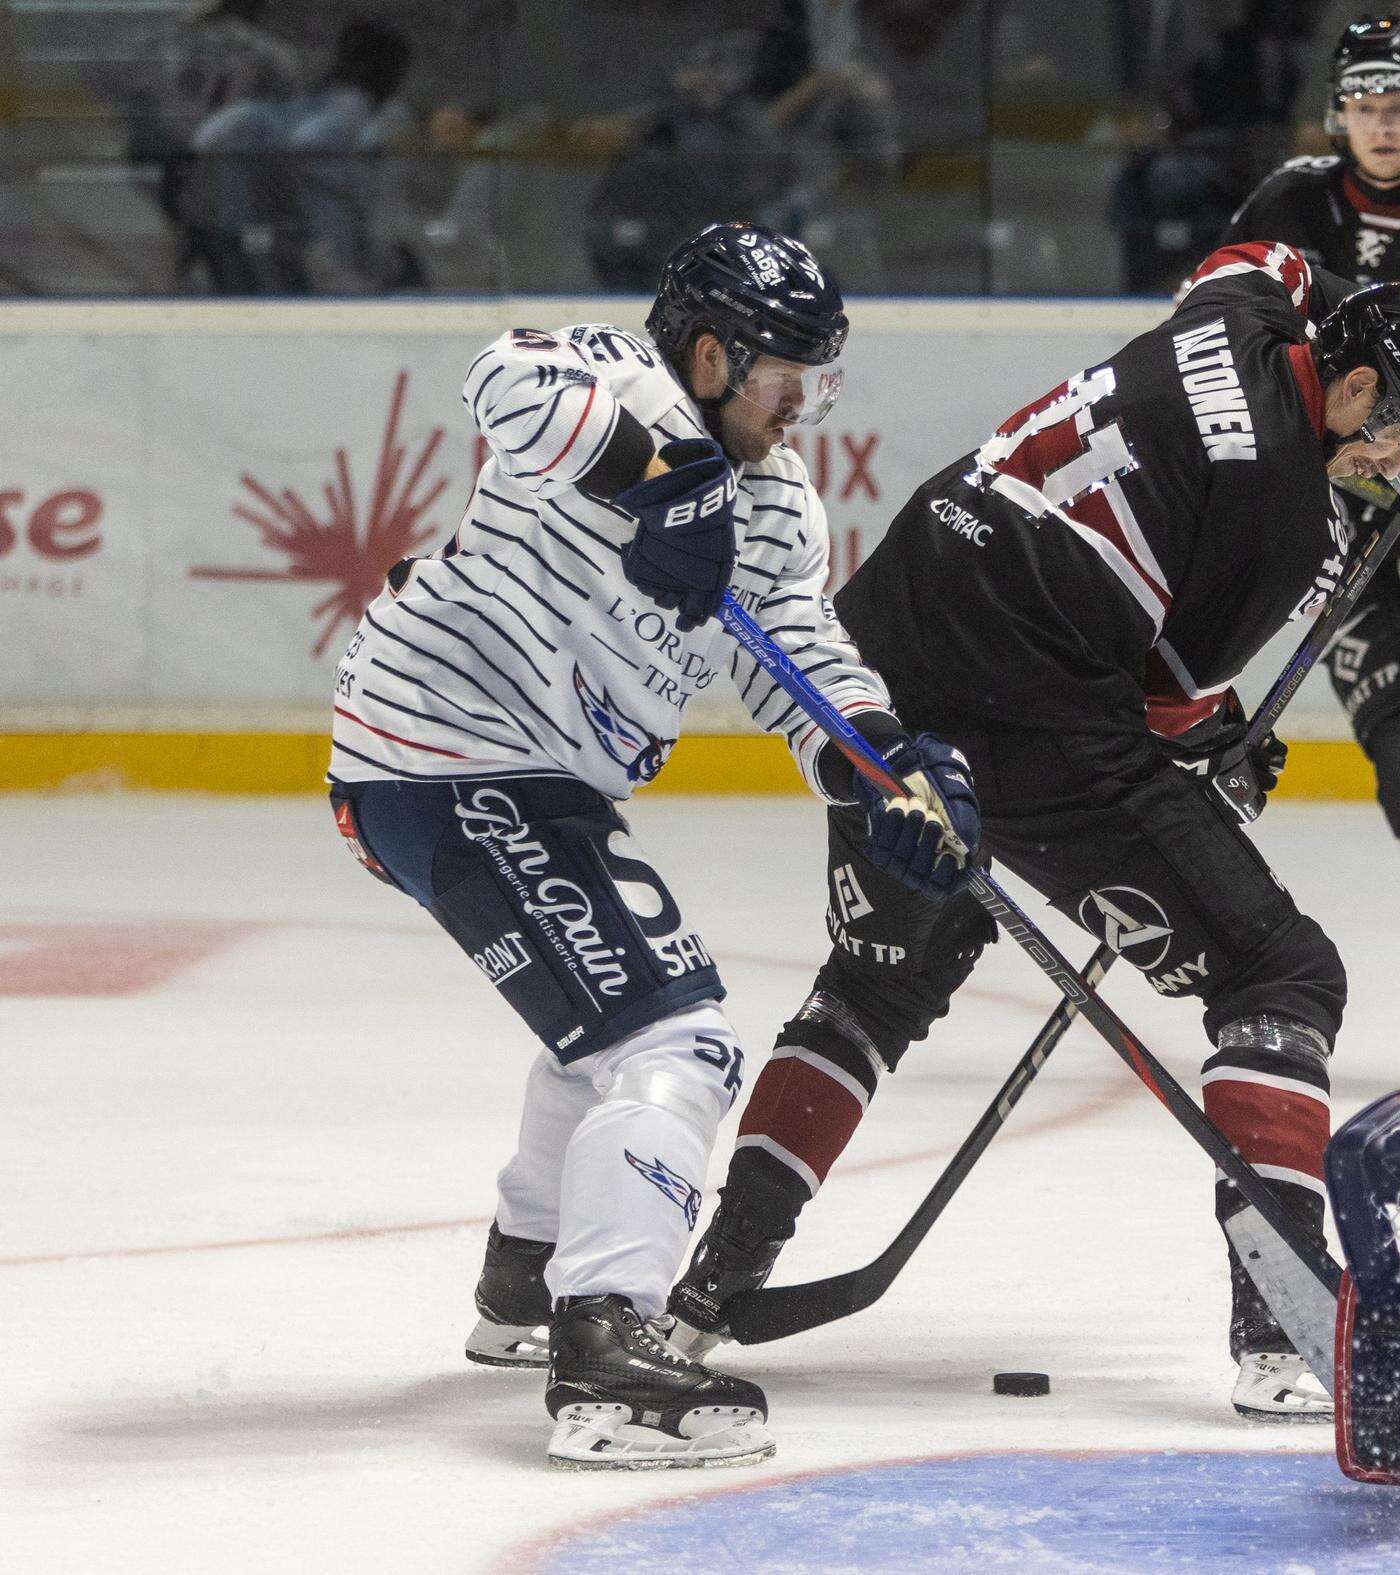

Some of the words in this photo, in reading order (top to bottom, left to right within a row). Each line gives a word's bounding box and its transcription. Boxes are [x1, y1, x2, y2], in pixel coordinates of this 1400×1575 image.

[750, 247, 787, 288] abgi
[728, 620, 778, 670] BAUER
[1243, 802, 1258, 820] CCM
[871, 942, 906, 966] TP
[556, 1025, 585, 1050] BAUER
[681, 1286, 721, 1313] BAUER
